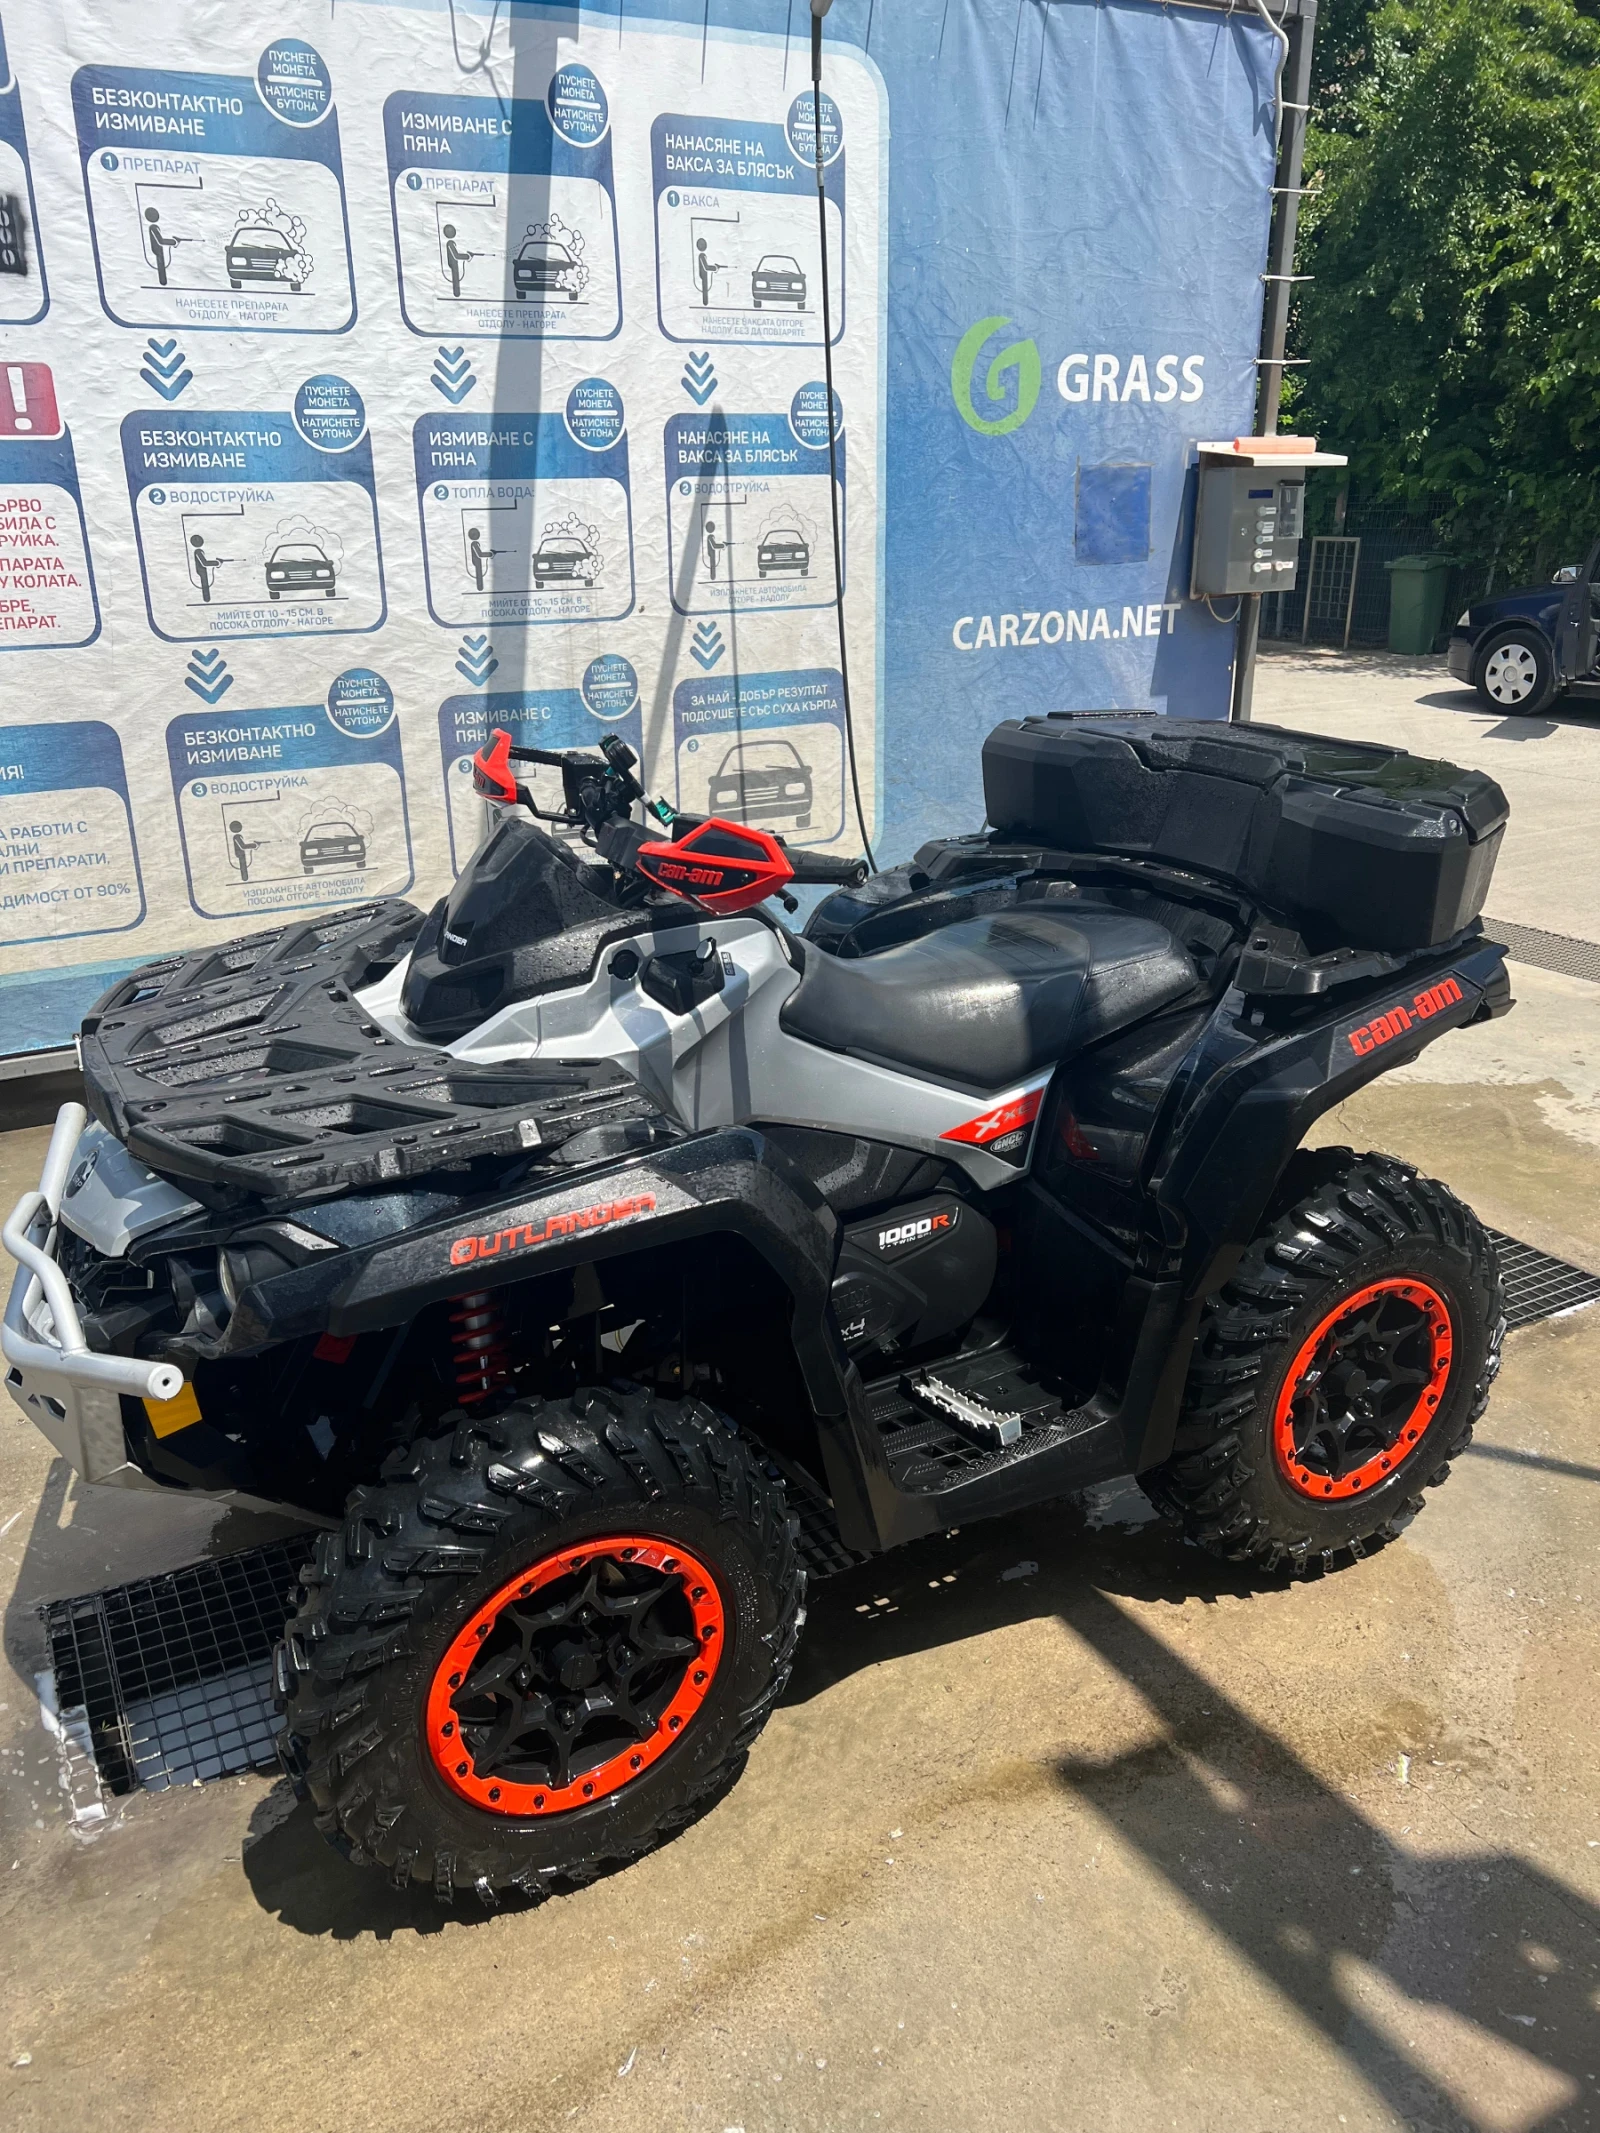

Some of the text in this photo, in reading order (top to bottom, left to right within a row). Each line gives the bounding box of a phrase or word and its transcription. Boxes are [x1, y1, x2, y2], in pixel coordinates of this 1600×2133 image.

[269, 51, 316, 64] ПУСНЕТЕ
[273, 63, 316, 77] МОНЕТА
[558, 74, 596, 89] ПУСНЕТЕ
[265, 86, 326, 101] НАТИСНЕТЕ
[561, 87, 595, 100] МОНЕТА
[92, 88, 243, 115] БЕЗКОНТАКТНО
[277, 98, 318, 112] БУТОНА
[554, 108, 604, 122] НАТИСНЕТЕ
[799, 112, 831, 123] МОНТА
[95, 111, 205, 136] ИЗМИВАНЕ
[401, 112, 512, 135] ИЗМИВАНЕ С
[563, 120, 597, 133] БУТОНА
[792, 131, 838, 143] НАТИСЕТЕ
[403, 135, 452, 154] ПЯНА
[665, 133, 764, 157] НАНАСЯНЕ НА
[123, 156, 200, 174] ПРЕПАРАТ
[666, 155, 795, 180] ВАКСА ЗА БЛЯСЪК
[426, 177, 494, 193] ПРЕПАРАТ
[683, 195, 720, 208] ВАКСА
[175, 298, 289, 311] НАНЕСЕТЕ ПРЕПАРАТА
[189, 309, 278, 322] ОТДОЛУ НАГОРЕ
[467, 309, 566, 319] НАНЕСЕТЕ ПРЕПАРАТА
[479, 320, 556, 329] ОТДОЛУ НАГОРЕ
[1057, 354, 1205, 402] GRASS
[304, 386, 350, 396] ПУСНЕТЕ
[575, 388, 614, 398] ПУСНЕТЕ
[800, 391, 828, 400] ПУСНЕТ
[308, 397, 349, 407] МОНЕТА
[578, 399, 612, 409] МОНЕТА
[801, 401, 828, 410] МОНЕТ
[302, 418, 360, 428] НАТИСНЕТЕ
[571, 418, 620, 428] НАТИСНЕТЕ
[795, 419, 838, 427] НАТИСНЕЕ
[140, 431, 282, 446] БЕЗКОНТАКТНО
[312, 429, 352, 438] БУТОНА
[429, 431, 534, 446] ИЗМИВАНЕ С
[580, 428, 614, 438] БУТОНА
[678, 431, 770, 444] НАНАСЯНЕ НА
[143, 452, 246, 469] ИЗМИВАНЕ
[431, 452, 477, 466] ПЯНА
[679, 449, 798, 463] ВАКСА ЗА БЛЯСЪК
[451, 487, 495, 499] ТОПЛА
[694, 481, 770, 495] ВОДОСТРУЙКА
[170, 488, 274, 504] ВОДОСТРУЙКА
[45, 516, 57, 530] С
[13, 574, 82, 588] КОЛАТА.
[489, 598, 519, 608] МИЙТЕ
[520, 599, 531, 607] ОТ
[217, 608, 251, 620] МИЙТЕ
[253, 610, 265, 619] ОТ
[268, 609, 278, 619] 10
[286, 608, 297, 617] 15
[481, 608, 518, 618] ПОСОКА
[558, 605, 591, 614] НАГОРЕ
[209, 617, 334, 631] ПОСОКА ОТДОЛУ НАГОРЕ
[952, 604, 1181, 650] CARZONA.NET
[591, 663, 628, 672] ПУСНЕТЕ
[337, 678, 380, 688] ПУСНЕТЕ
[594, 672, 626, 682] МОНЕТА
[341, 687, 379, 698] МОНЕТА
[588, 689, 634, 700] НАТИСНЕТЕ
[691, 695, 705, 706] ЗА
[707, 691, 730, 704] НАЙ
[739, 689, 775, 703] ДОБЪР
[778, 684, 828, 698] РЕЗУЛТАТ
[595, 699, 628, 709] БУТОНА
[335, 706, 389, 717] НАТИСНЕТЕ
[454, 707, 551, 724] ИЗМИВАНЕ С
[682, 699, 838, 724] ПОДСУШЕТЕ СЪС СУХА КЪРПА
[344, 716, 382, 726] БУТОНА
[184, 723, 316, 746] БЕЗКОНТАКТНО
[456, 729, 487, 742] ПЯН
[187, 745, 282, 765] ИЗМИВАНЕ
[211, 776, 308, 795] ВОДОСТРУЙКА
[11, 822, 73, 839] РАБОТИ
[78, 821, 87, 833] С
[658, 862, 723, 886] can-am
[243, 877, 366, 897] ИЗПЛАКНЕТЕ АВТОМОБИЛА
[0, 882, 130, 910] ДИМОСТ ОТ 90%
[248, 895, 285, 906] ПОСОКА
[328, 885, 364, 896] НАДОЛУ
[444, 931, 467, 946] ANDER
[1348, 977, 1464, 1056] can-am
[450, 1191, 656, 1266] OUTLANDER
[879, 1214, 950, 1246] 1000R
